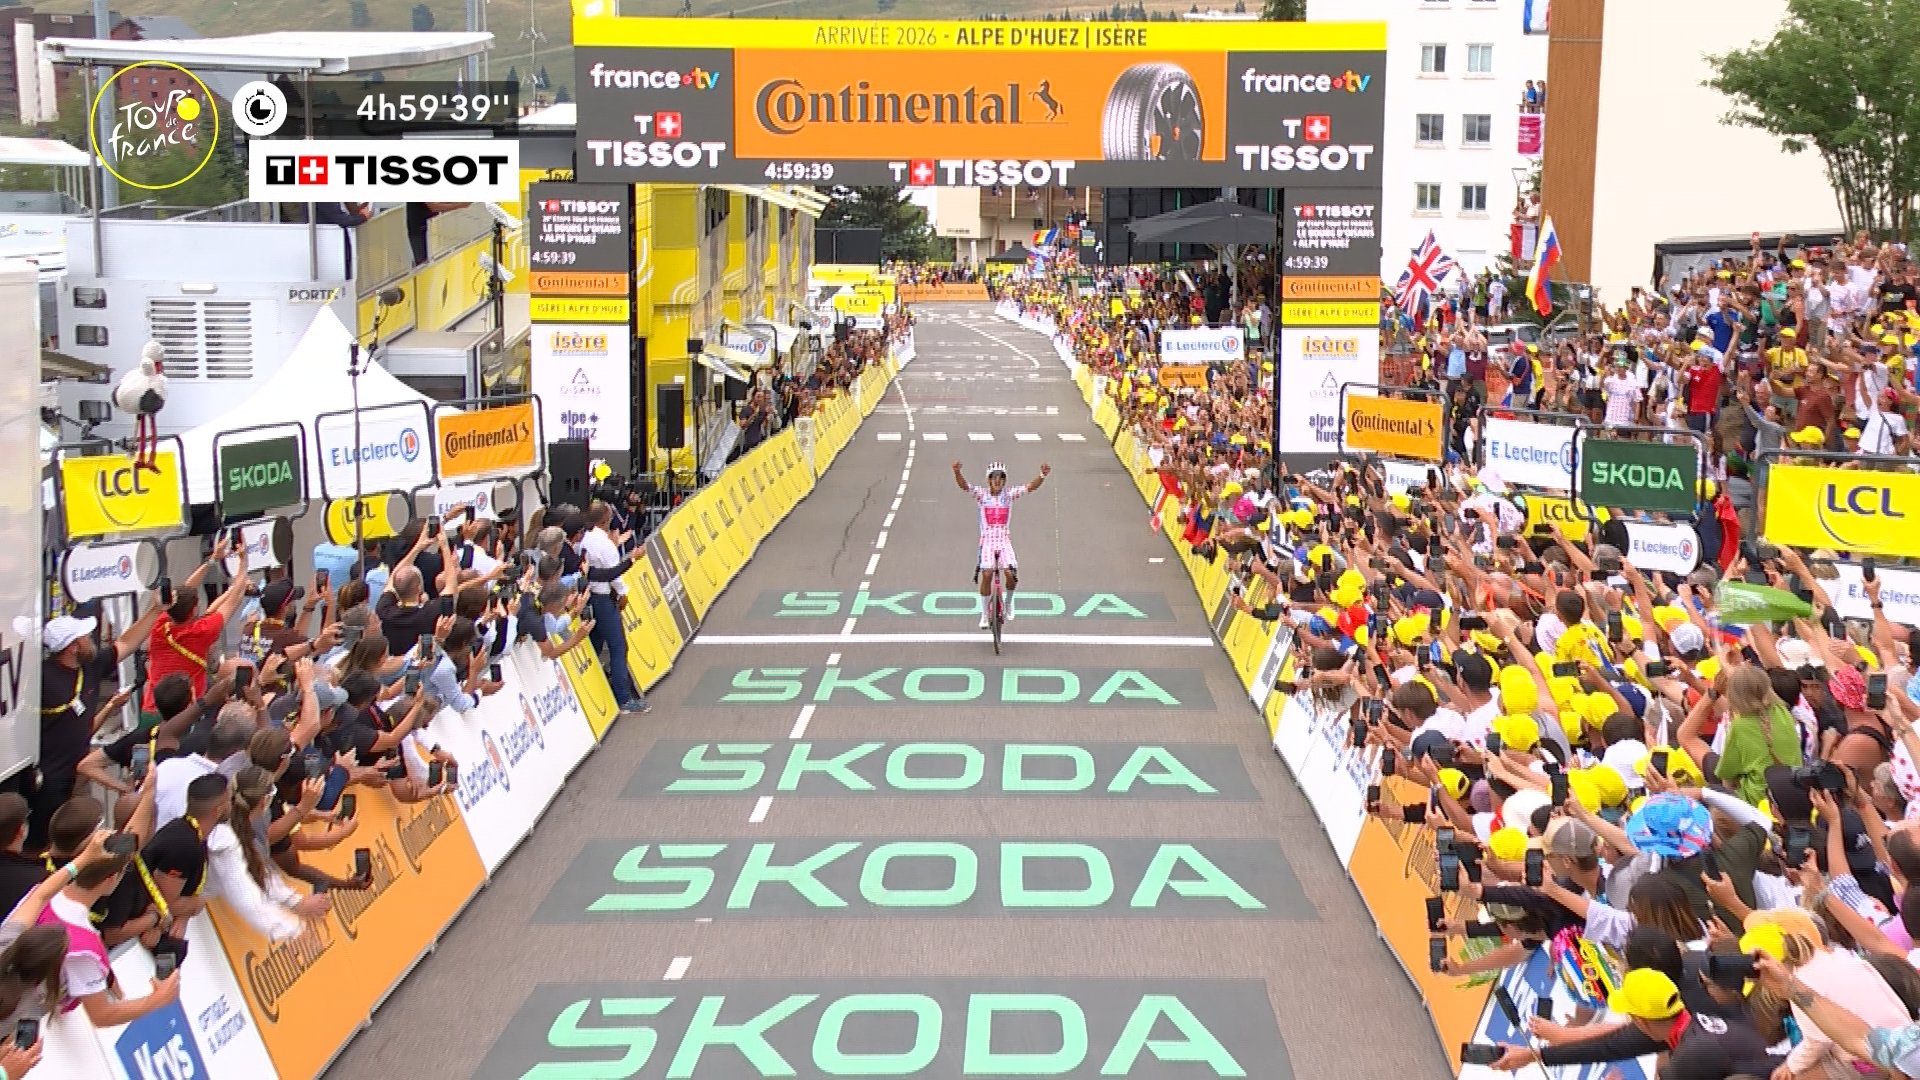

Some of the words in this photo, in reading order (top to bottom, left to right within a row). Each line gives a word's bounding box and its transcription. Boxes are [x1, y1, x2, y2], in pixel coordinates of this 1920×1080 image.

[815, 22, 889, 46] ARRIVÉE
[896, 27, 938, 46] 2026
[957, 28, 1004, 46] ALPE
[1011, 28, 1079, 46] D'HUEZ
[1096, 24, 1147, 46] ISÈRE
[756, 79, 1022, 135] Continental
[586, 140, 726, 168] TISSOT
[1234, 145, 1374, 171] TISSOT
[764, 162, 834, 181] 4:59:39
[940, 161, 1075, 186] TISSOT
[561, 200, 620, 213] TISSOT
[1315, 205, 1374, 218] TISSOT
[532, 252, 576, 264] 4:59:39
[1285, 256, 1329, 269] 4:59:39
[538, 276, 609, 291] Continental
[1290, 281, 1361, 295] Continental
[560, 410, 587, 425] alpe
[1309, 413, 1334, 428] alpe
[1351, 409, 1423, 436] Continental
[444, 427, 518, 459] Continental
[1491, 440, 1559, 465] E.Leclerc
[100, 464, 150, 497] LCL
[1827, 483, 1905, 518] LCL
[1543, 503, 1575, 522] LCL
